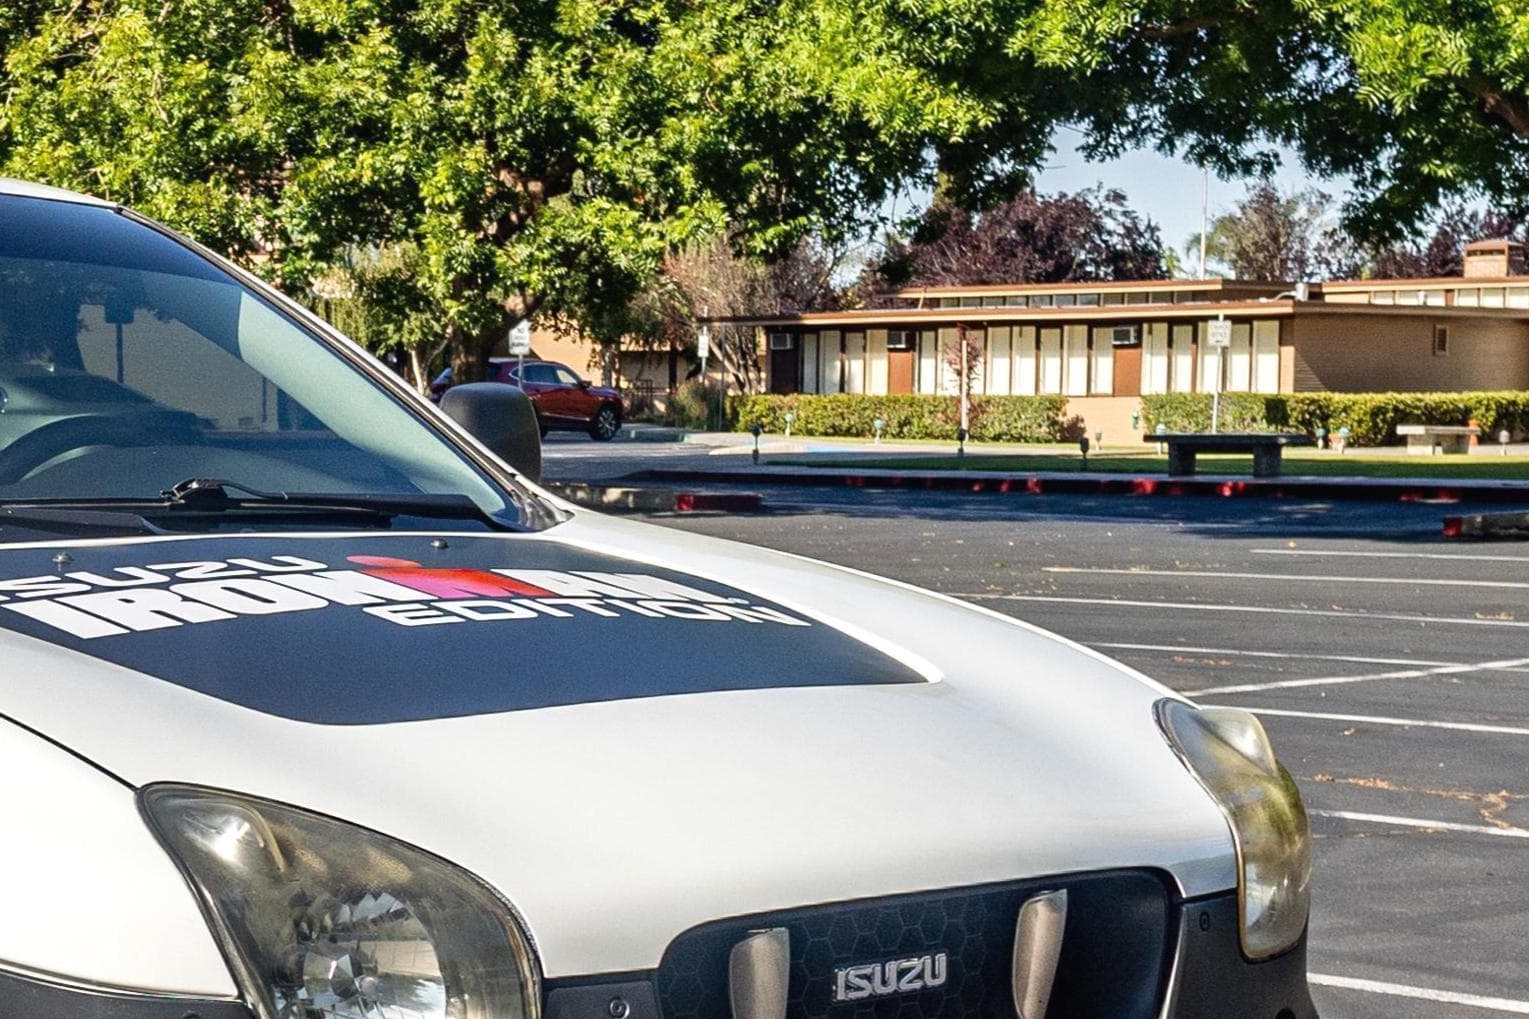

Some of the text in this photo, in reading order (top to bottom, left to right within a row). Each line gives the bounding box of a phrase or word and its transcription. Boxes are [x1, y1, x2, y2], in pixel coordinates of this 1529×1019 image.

[0, 555, 732, 640] IRONMAN
[362, 598, 813, 627] EDITION
[833, 953, 947, 1001] ISUZU
